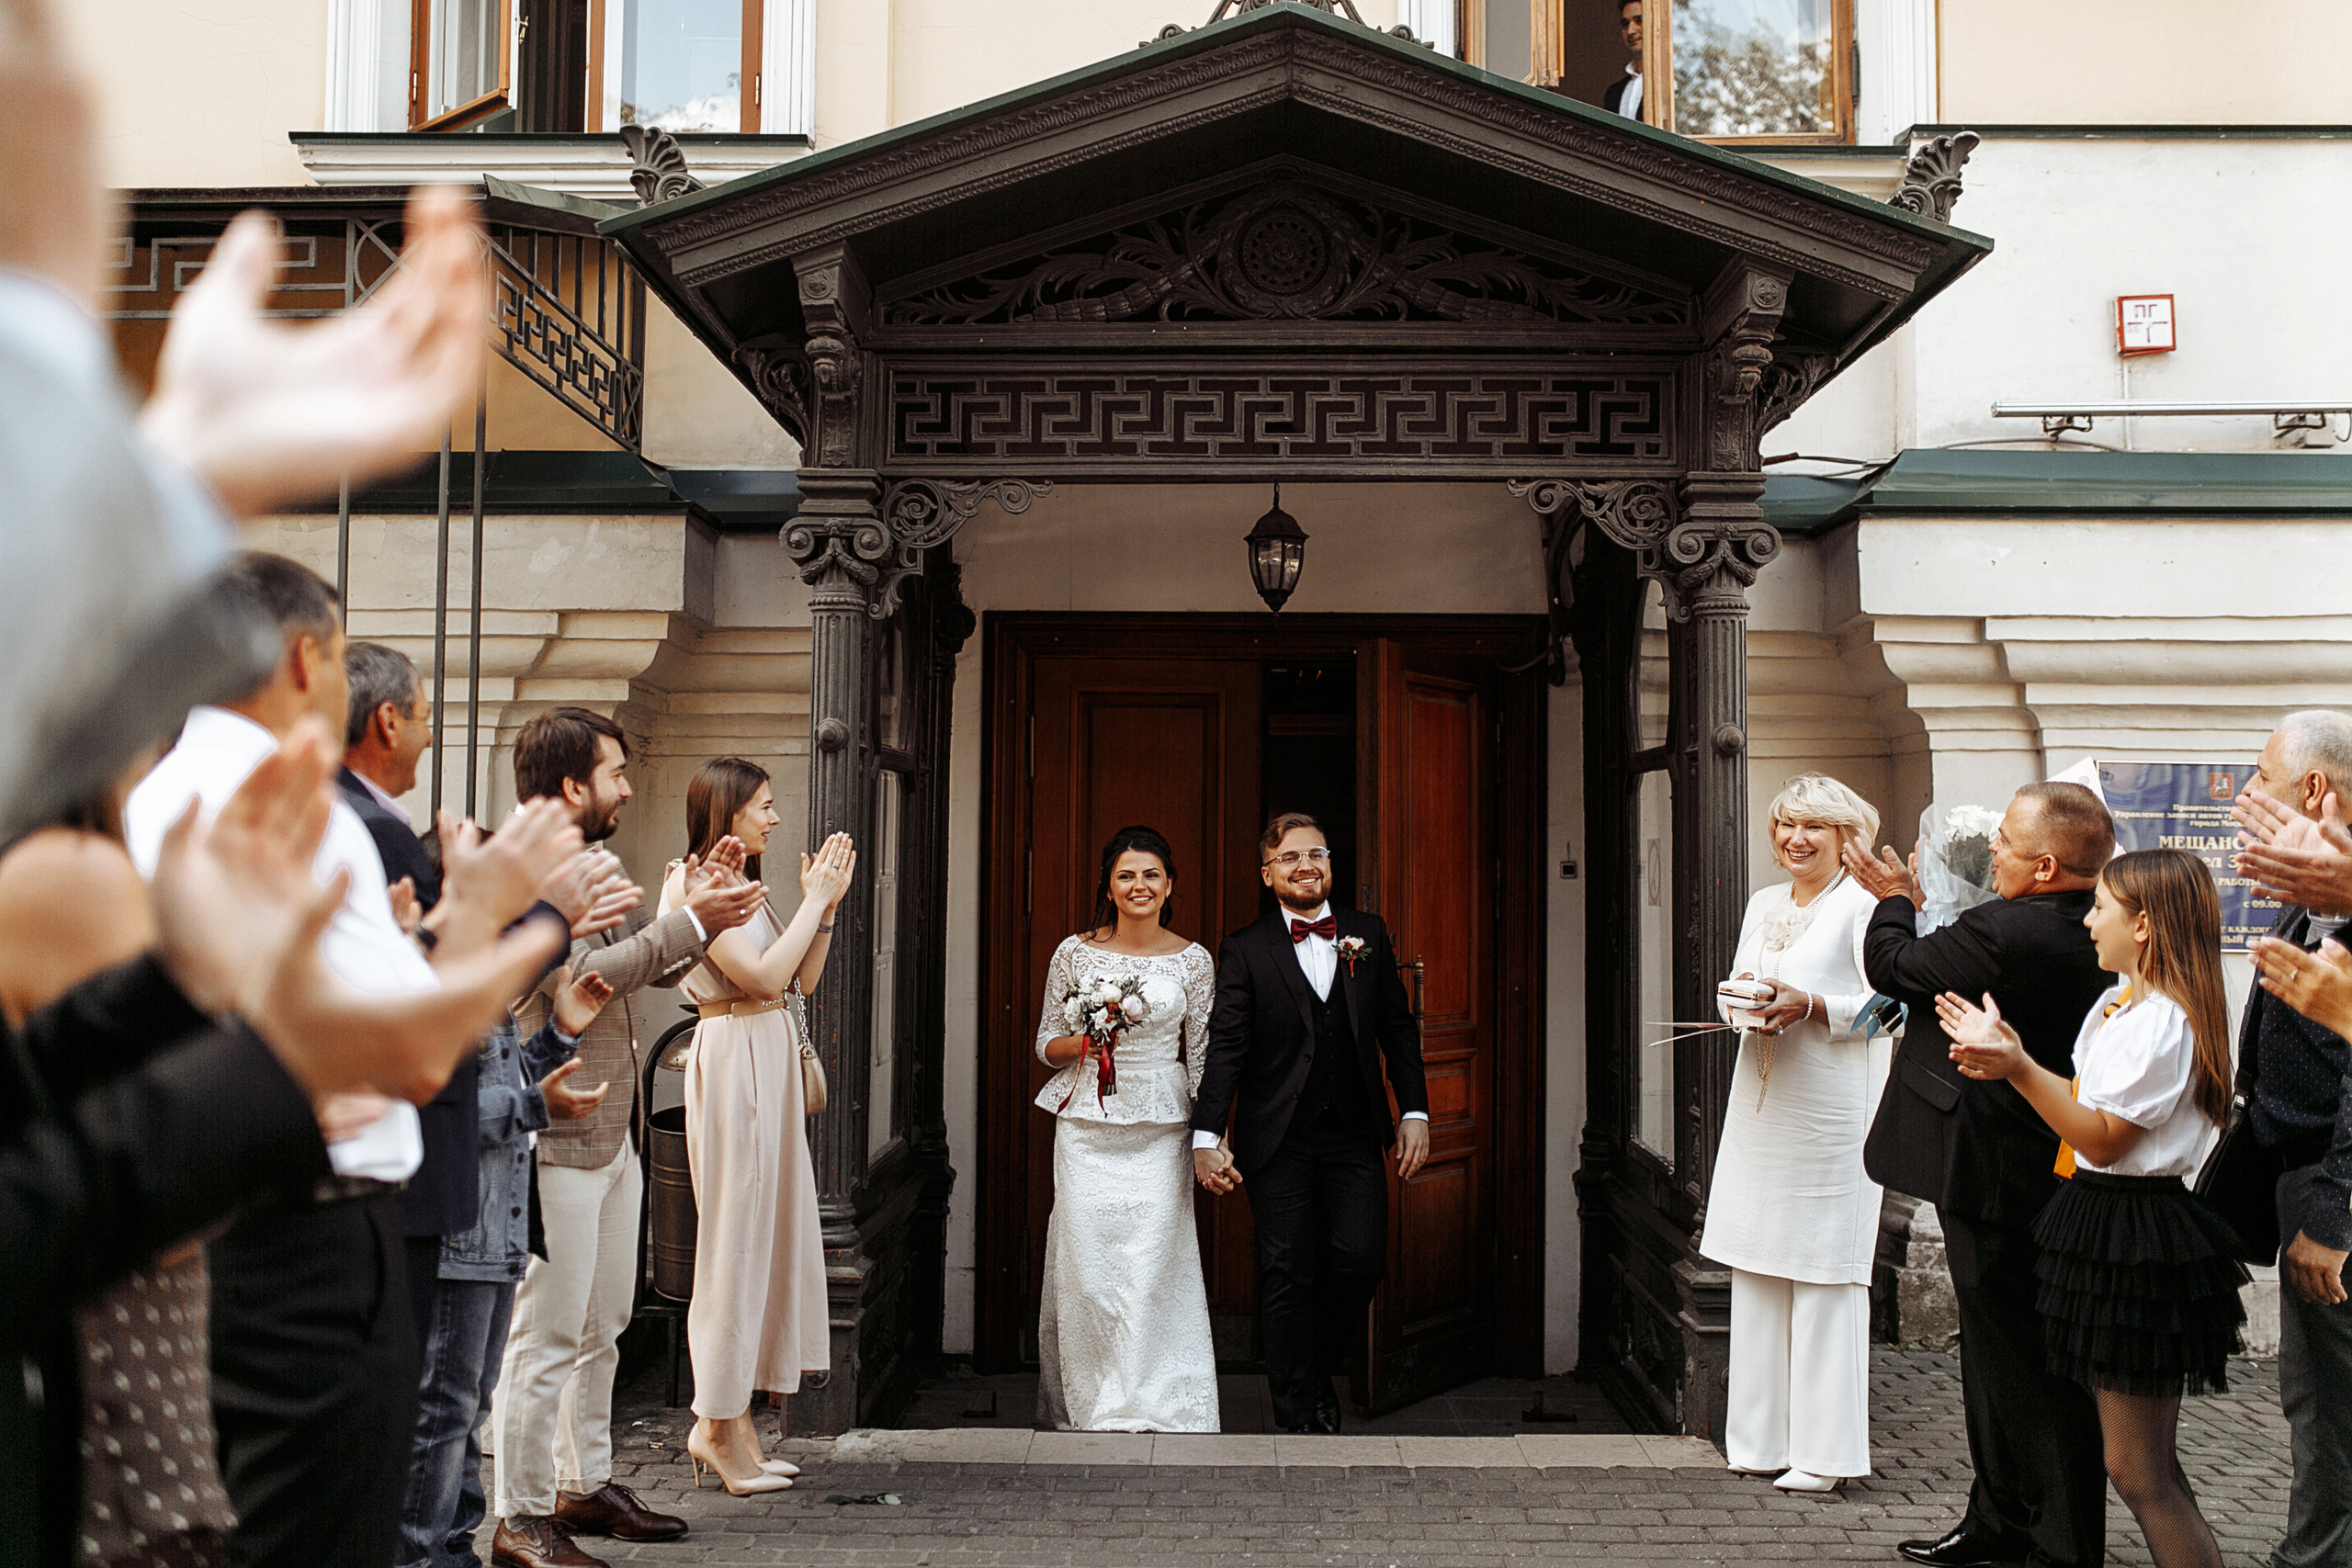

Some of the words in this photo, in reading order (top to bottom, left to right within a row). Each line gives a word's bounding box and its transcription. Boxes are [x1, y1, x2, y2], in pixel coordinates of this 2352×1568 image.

[2134, 304, 2157, 318] ПГ
[2173, 804, 2233, 813] Правительств
[2115, 810, 2165, 819] Управление
[2189, 819, 2220, 828] города
[2159, 836, 2246, 852] МЕЩАНС
[2218, 877, 2262, 886] РАБОТЫ
[2252, 899, 2282, 908] 09.00
